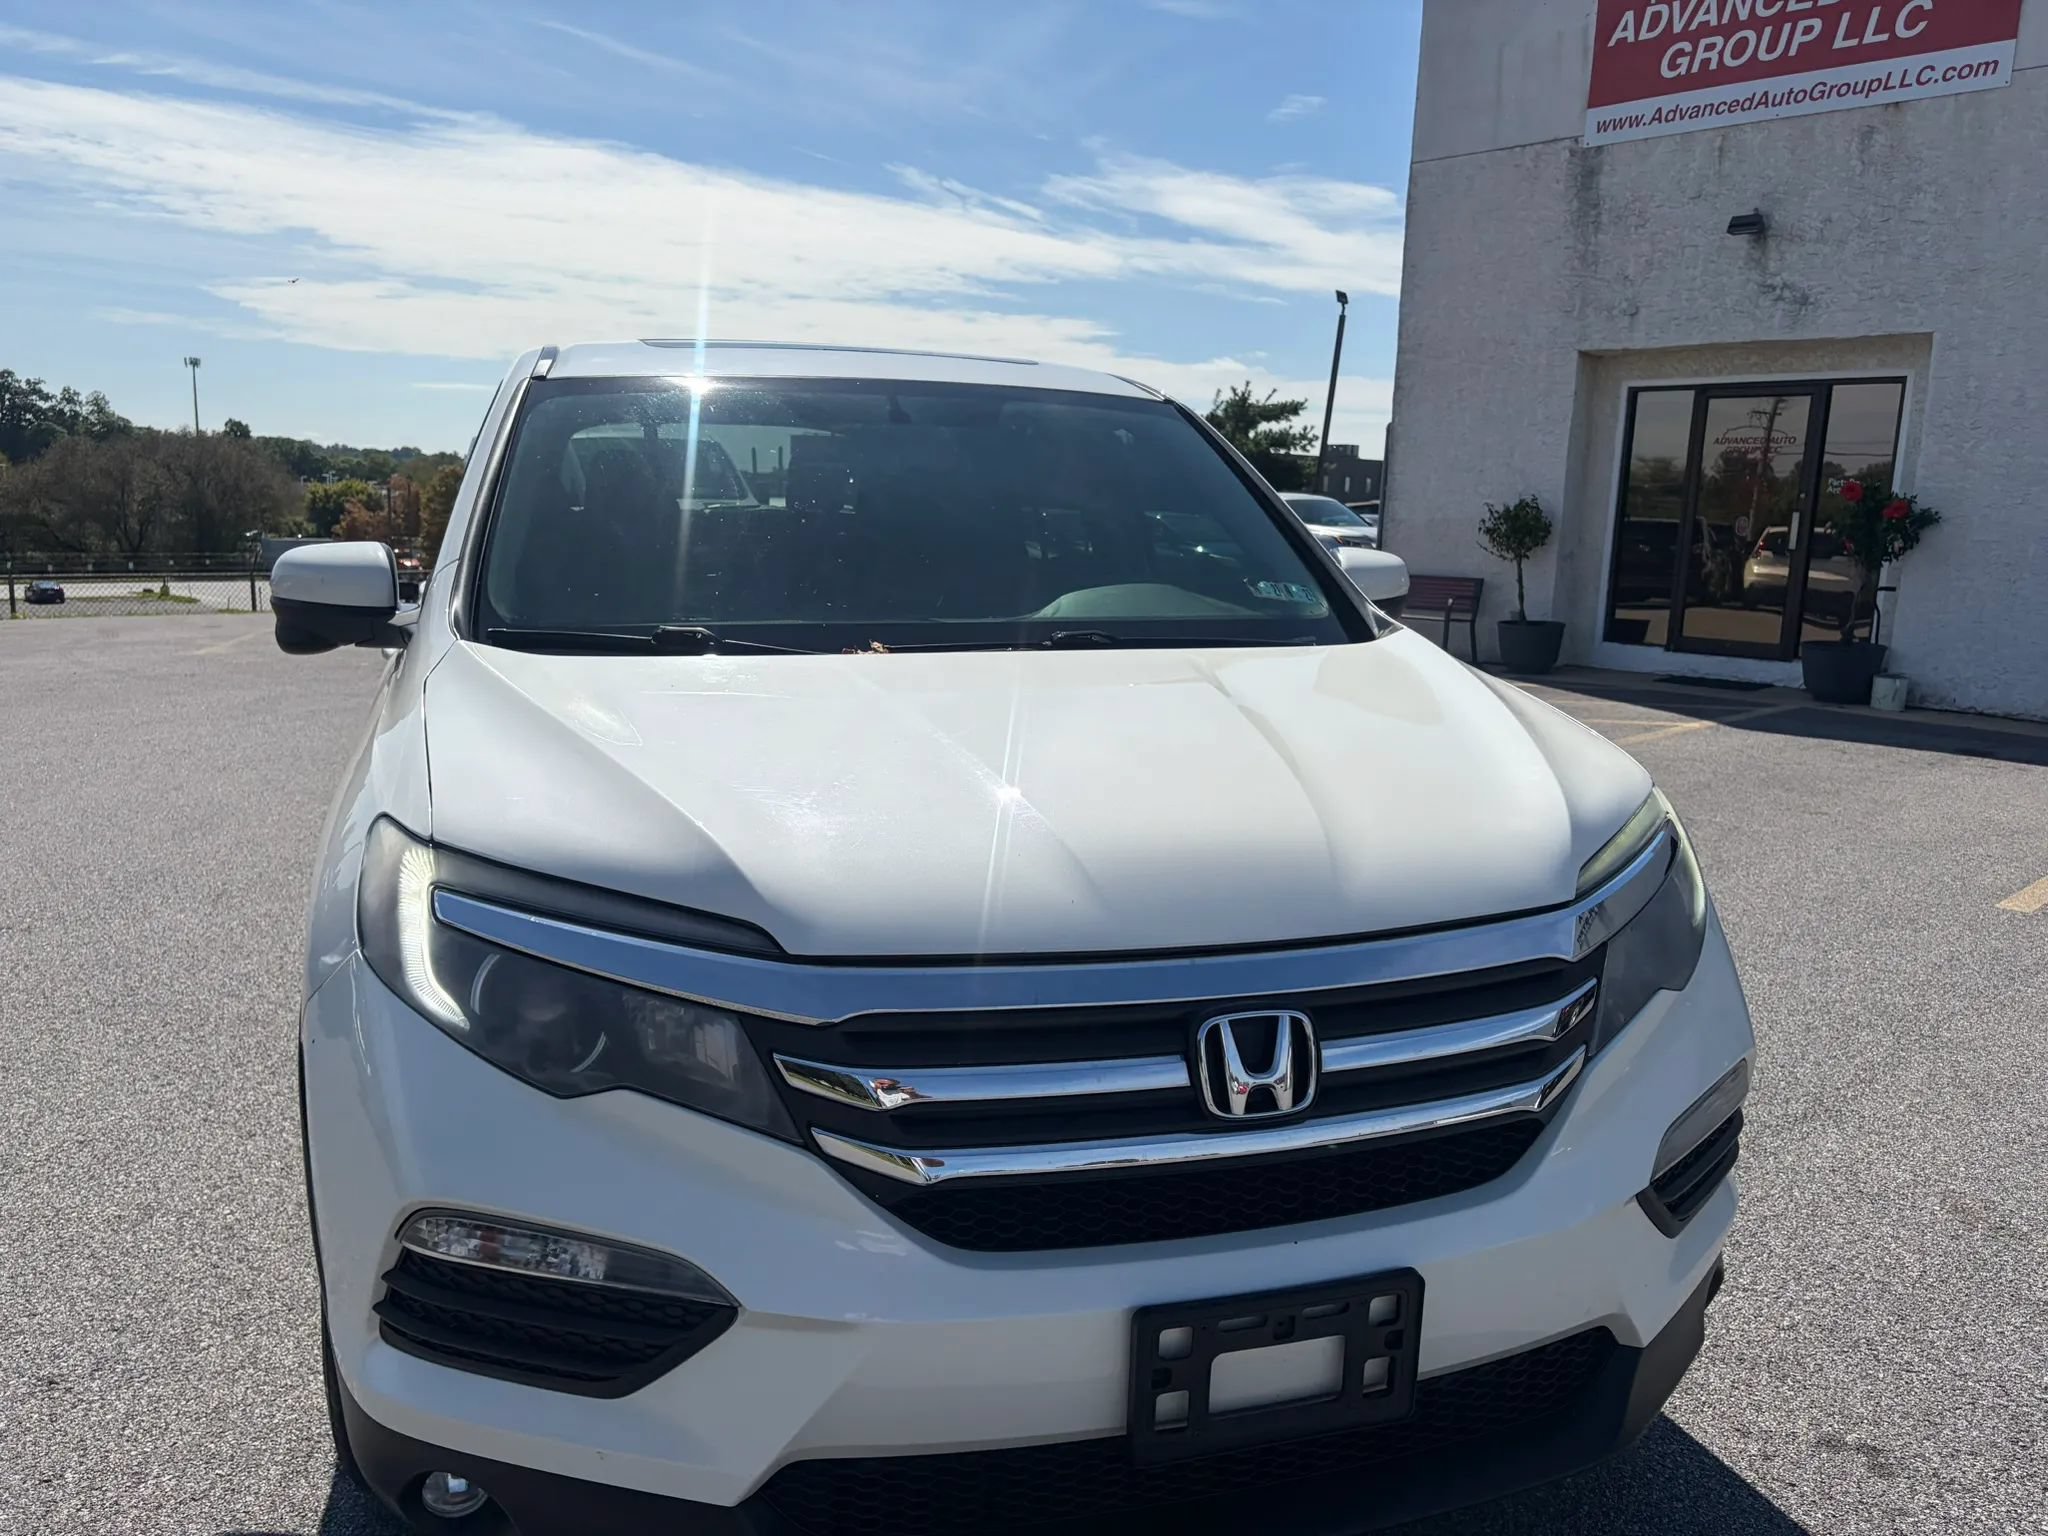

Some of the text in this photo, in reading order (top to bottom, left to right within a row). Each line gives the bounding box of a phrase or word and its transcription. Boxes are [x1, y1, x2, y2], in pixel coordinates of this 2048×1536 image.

[1608, 0, 1840, 47] ADVAN
[1660, 0, 1933, 79] GROUP LLC
[1596, 59, 2000, 134] www.AdvancedAutoGroupLLC.com
